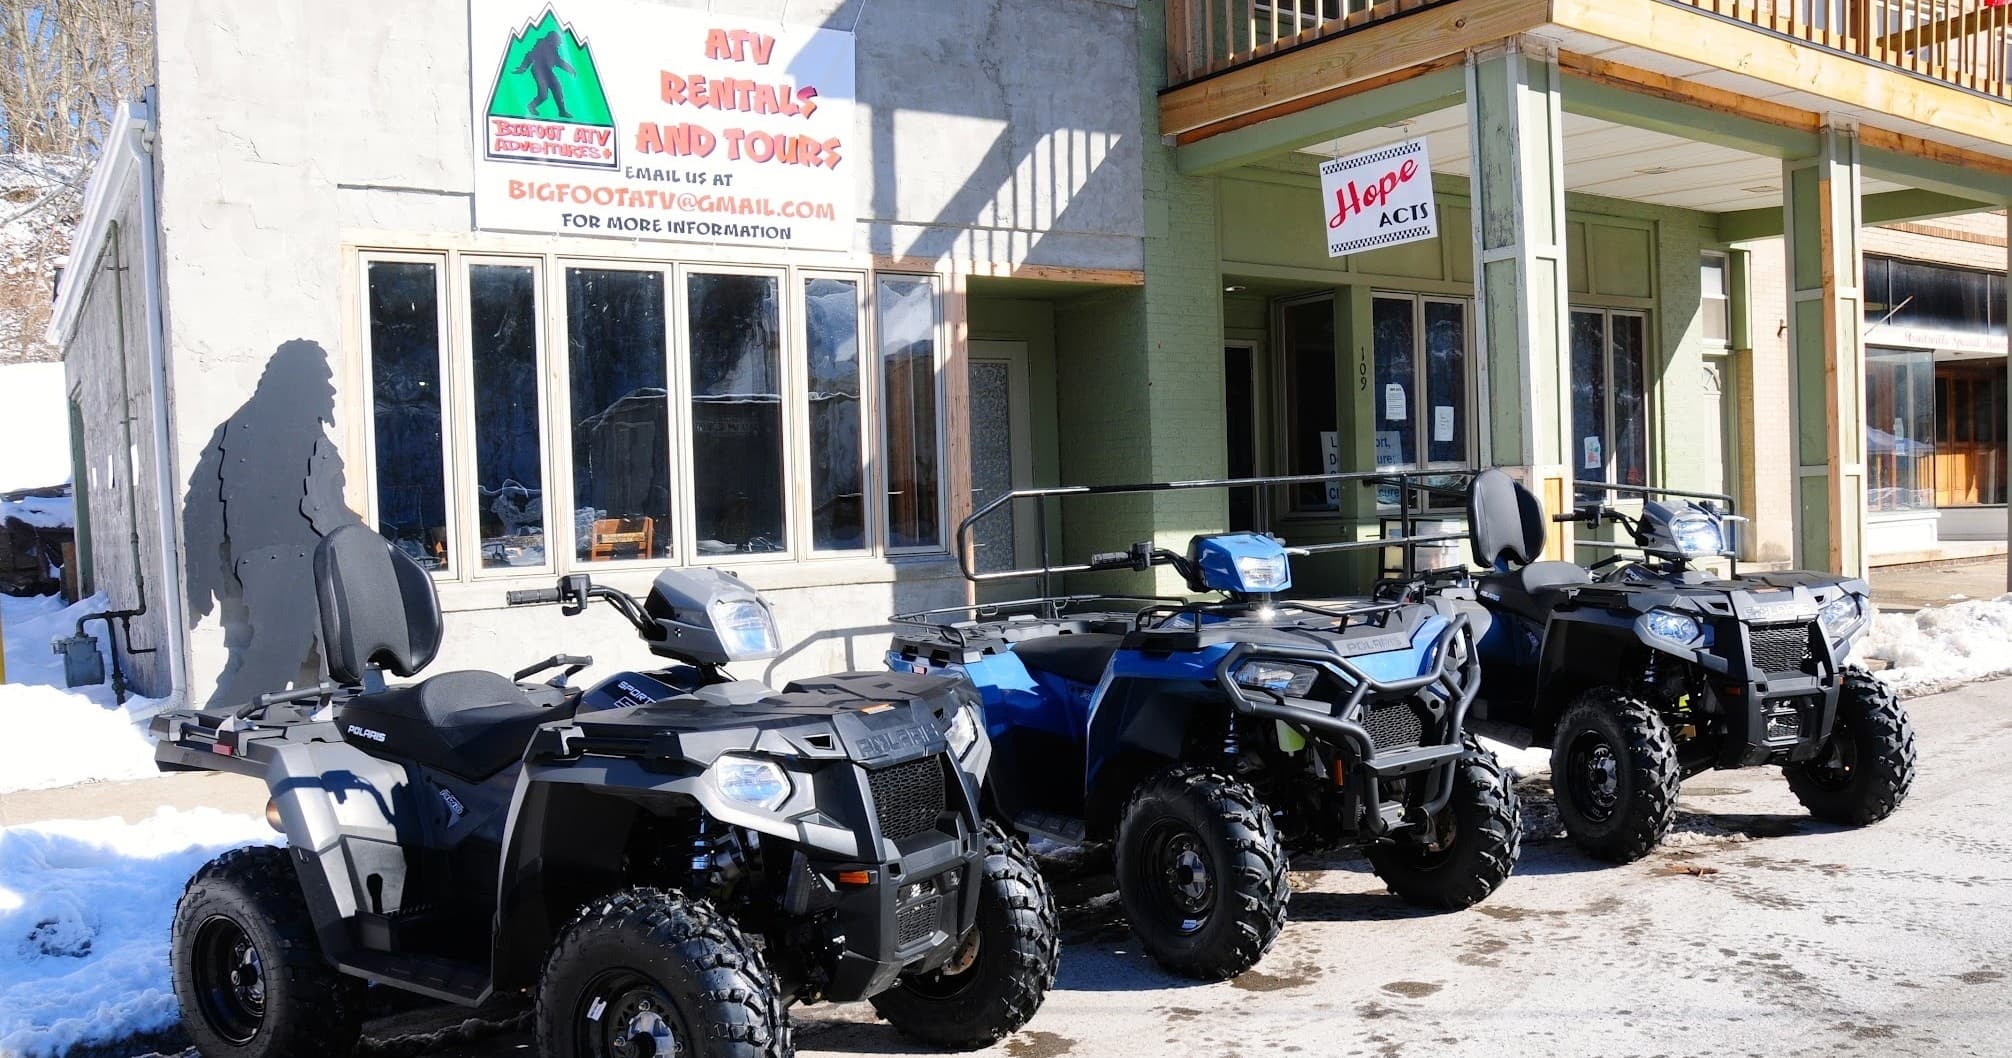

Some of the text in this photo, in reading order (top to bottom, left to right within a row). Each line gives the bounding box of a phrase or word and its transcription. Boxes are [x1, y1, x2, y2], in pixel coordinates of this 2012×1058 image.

[704, 29, 776, 66] ATV
[660, 70, 818, 120] RENTALS
[492, 119, 611, 147] BIGFOOT ATV
[635, 122, 842, 171] AND TOURS
[625, 166, 733, 187] EMAIL US AT
[508, 179, 836, 222] BIGFOOTATV@GMAIL.COM
[1329, 159, 1419, 229] Hope
[562, 213, 792, 241] FOR MORE INFORMATION
[1379, 202, 1428, 228] ACTS
[618, 681, 657, 704] SPORT
[348, 724, 387, 743] POLARIS
